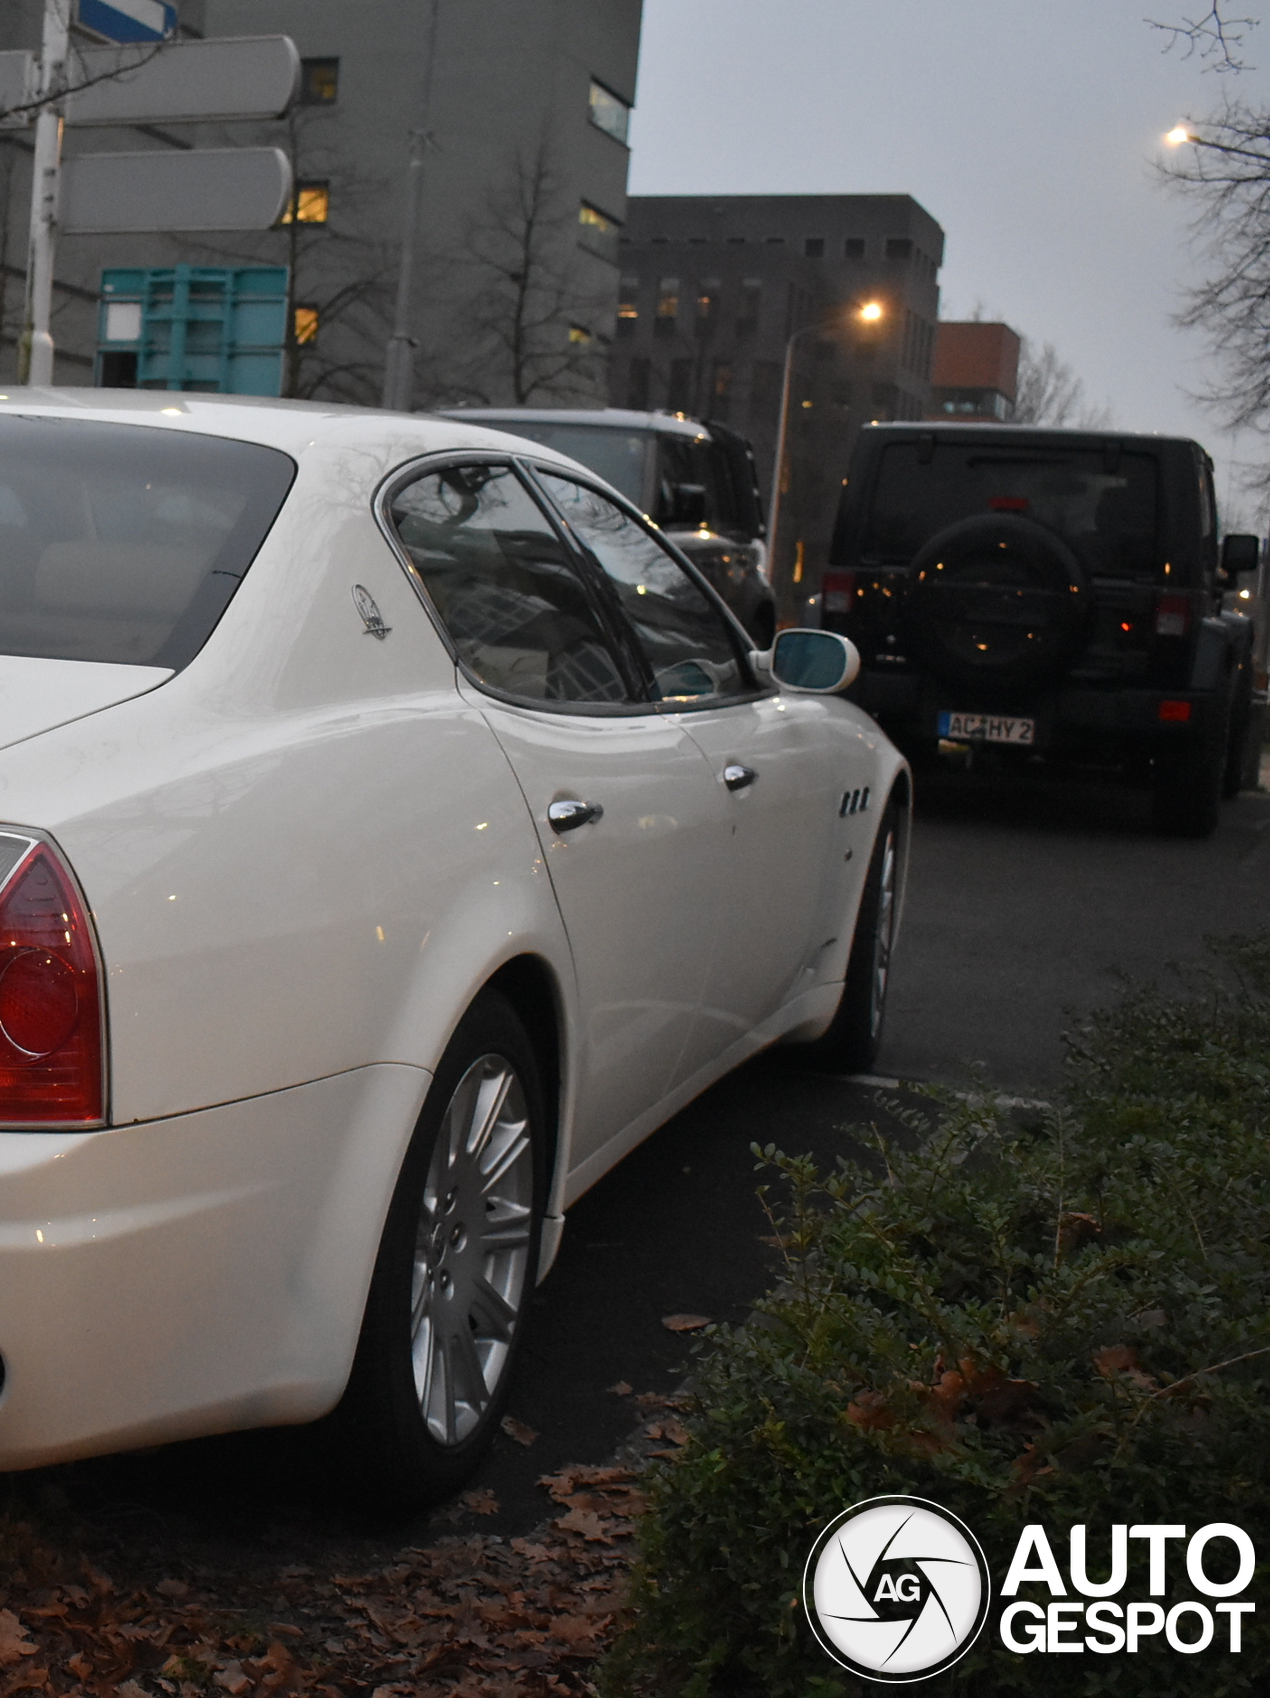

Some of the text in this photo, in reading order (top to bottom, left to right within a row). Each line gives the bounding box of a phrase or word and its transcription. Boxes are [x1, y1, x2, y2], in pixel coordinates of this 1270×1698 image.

[951, 716, 1031, 740] AC HY 2
